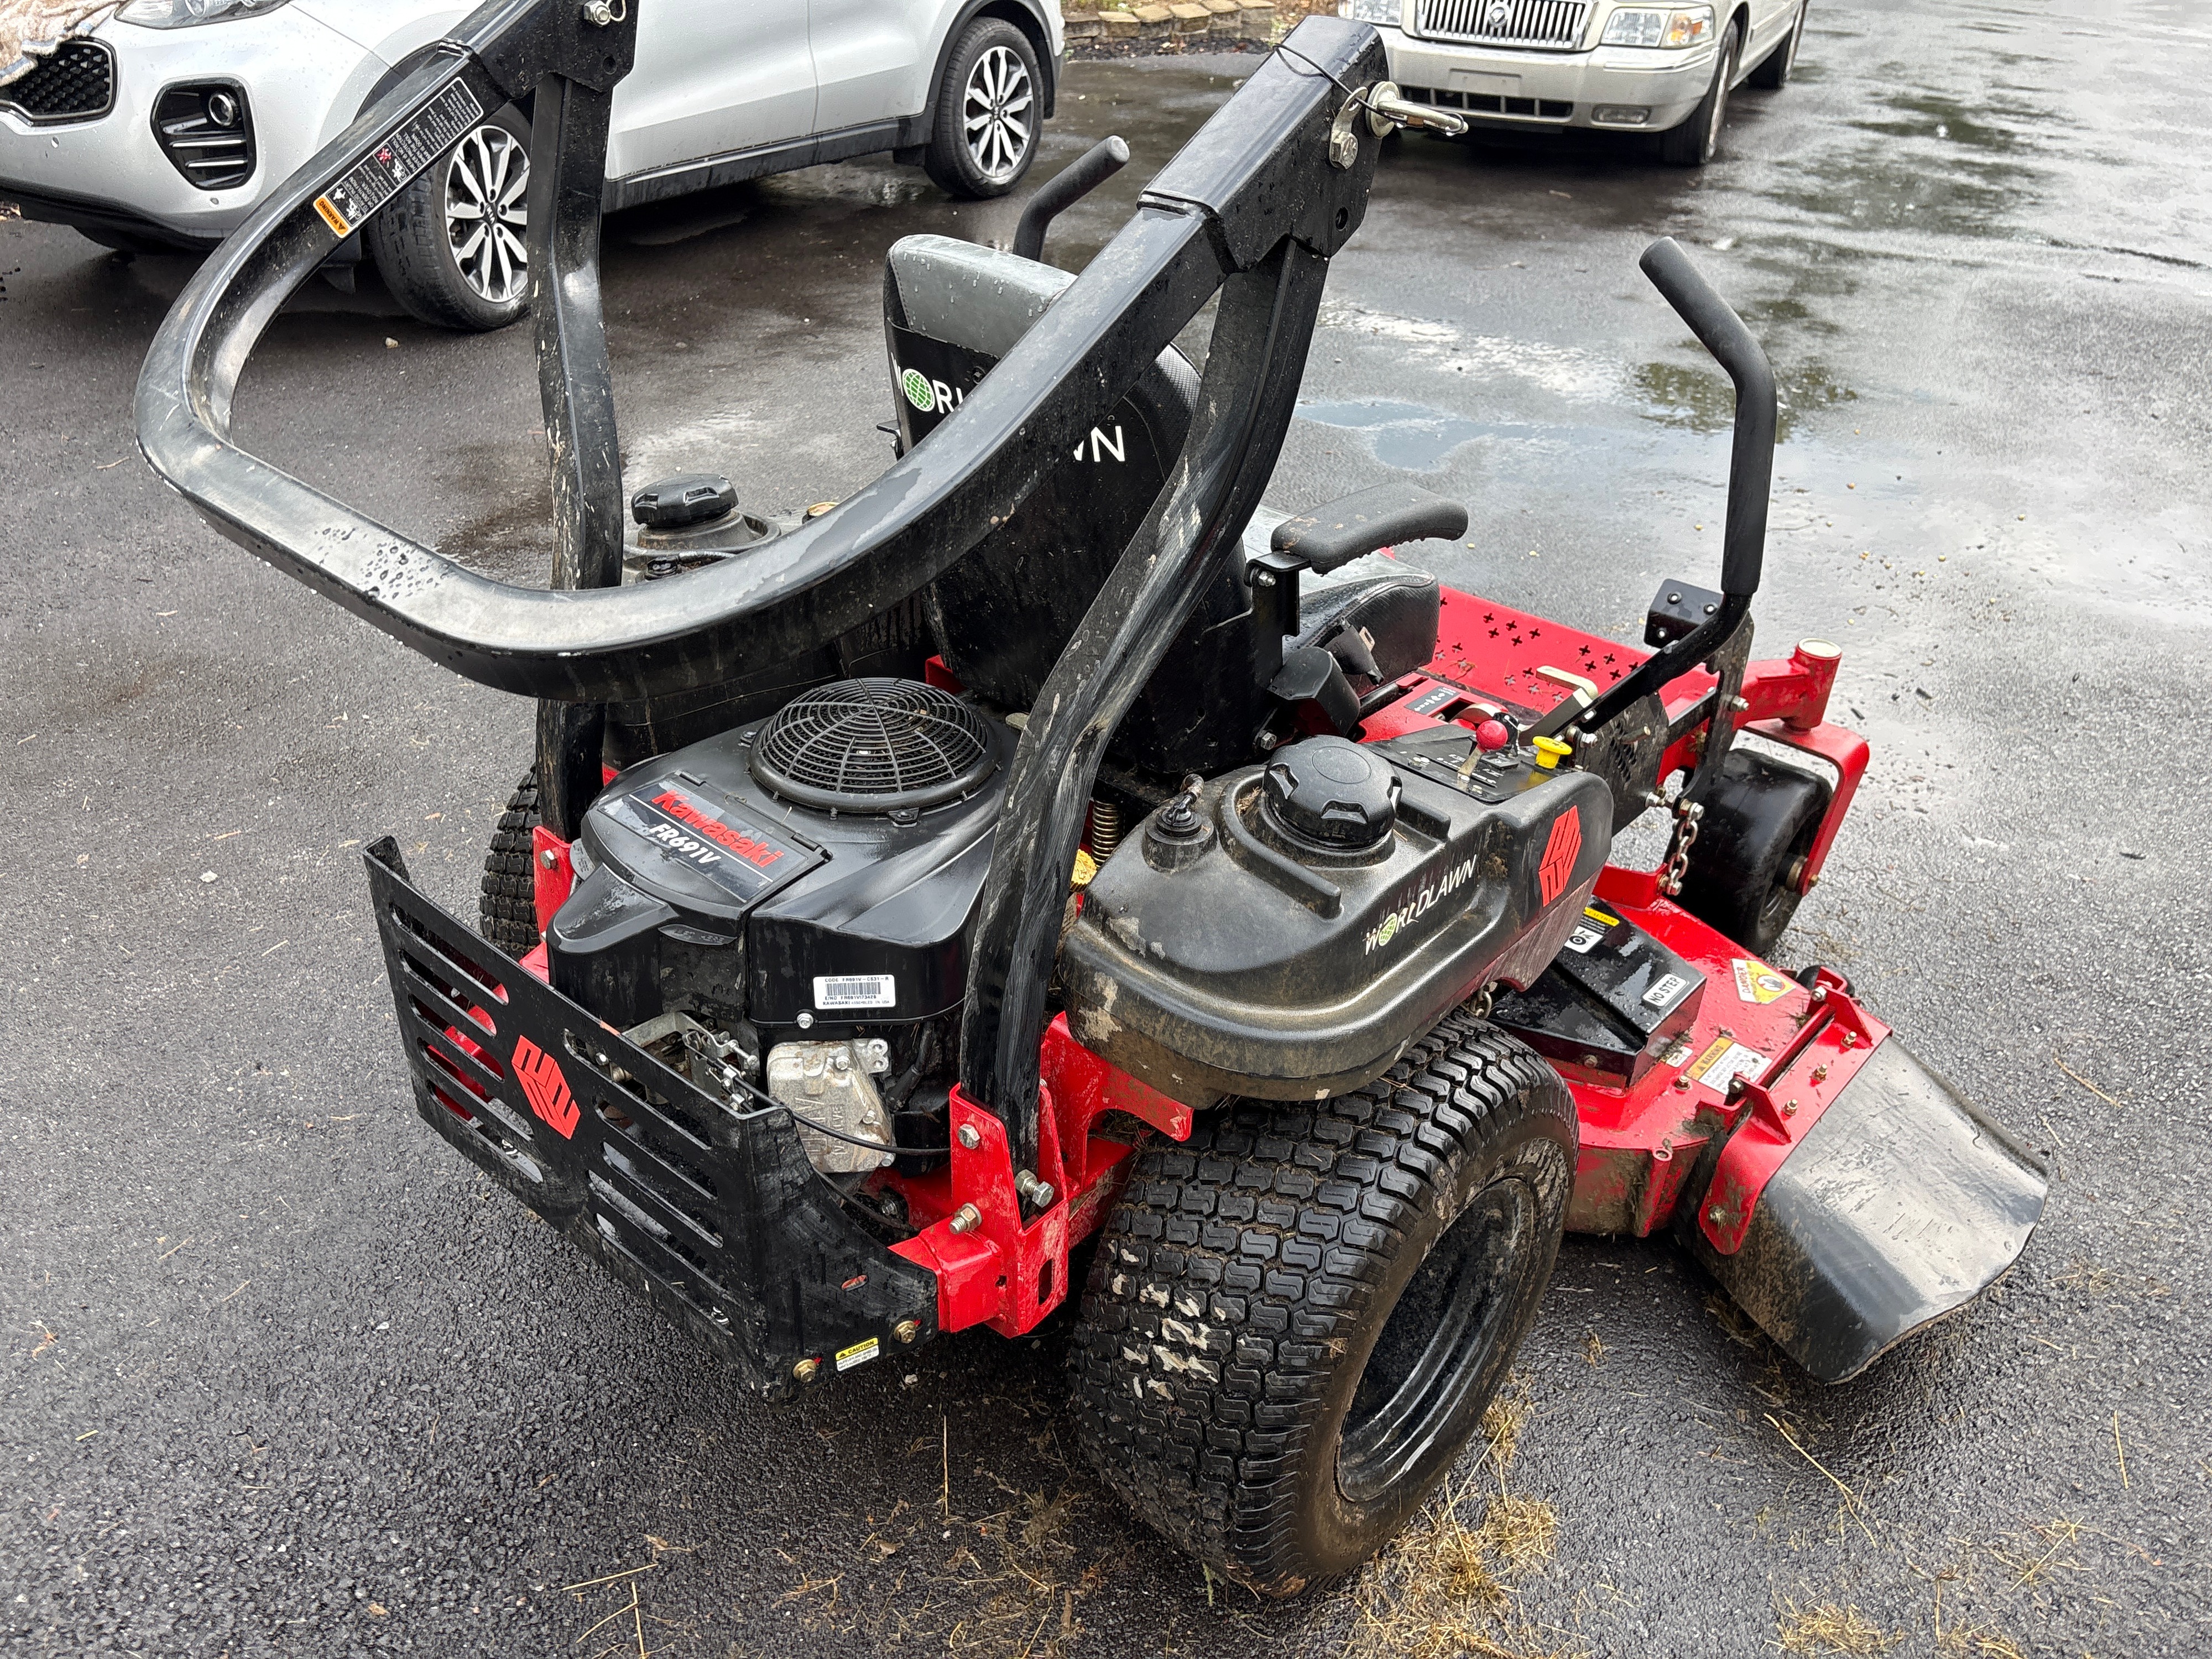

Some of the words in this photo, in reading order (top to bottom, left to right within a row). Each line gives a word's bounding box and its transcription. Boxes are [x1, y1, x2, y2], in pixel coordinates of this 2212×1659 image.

[319, 200, 340, 225] WARNING
[649, 823, 722, 863] FR691V
[651, 790, 784, 868] Kawasaki
[1365, 854, 1477, 956] WORLDLAWN
[1648, 992, 1665, 1003] NO
[1658, 977, 1680, 993] STEP
[848, 1340, 874, 1354] CAUTION
